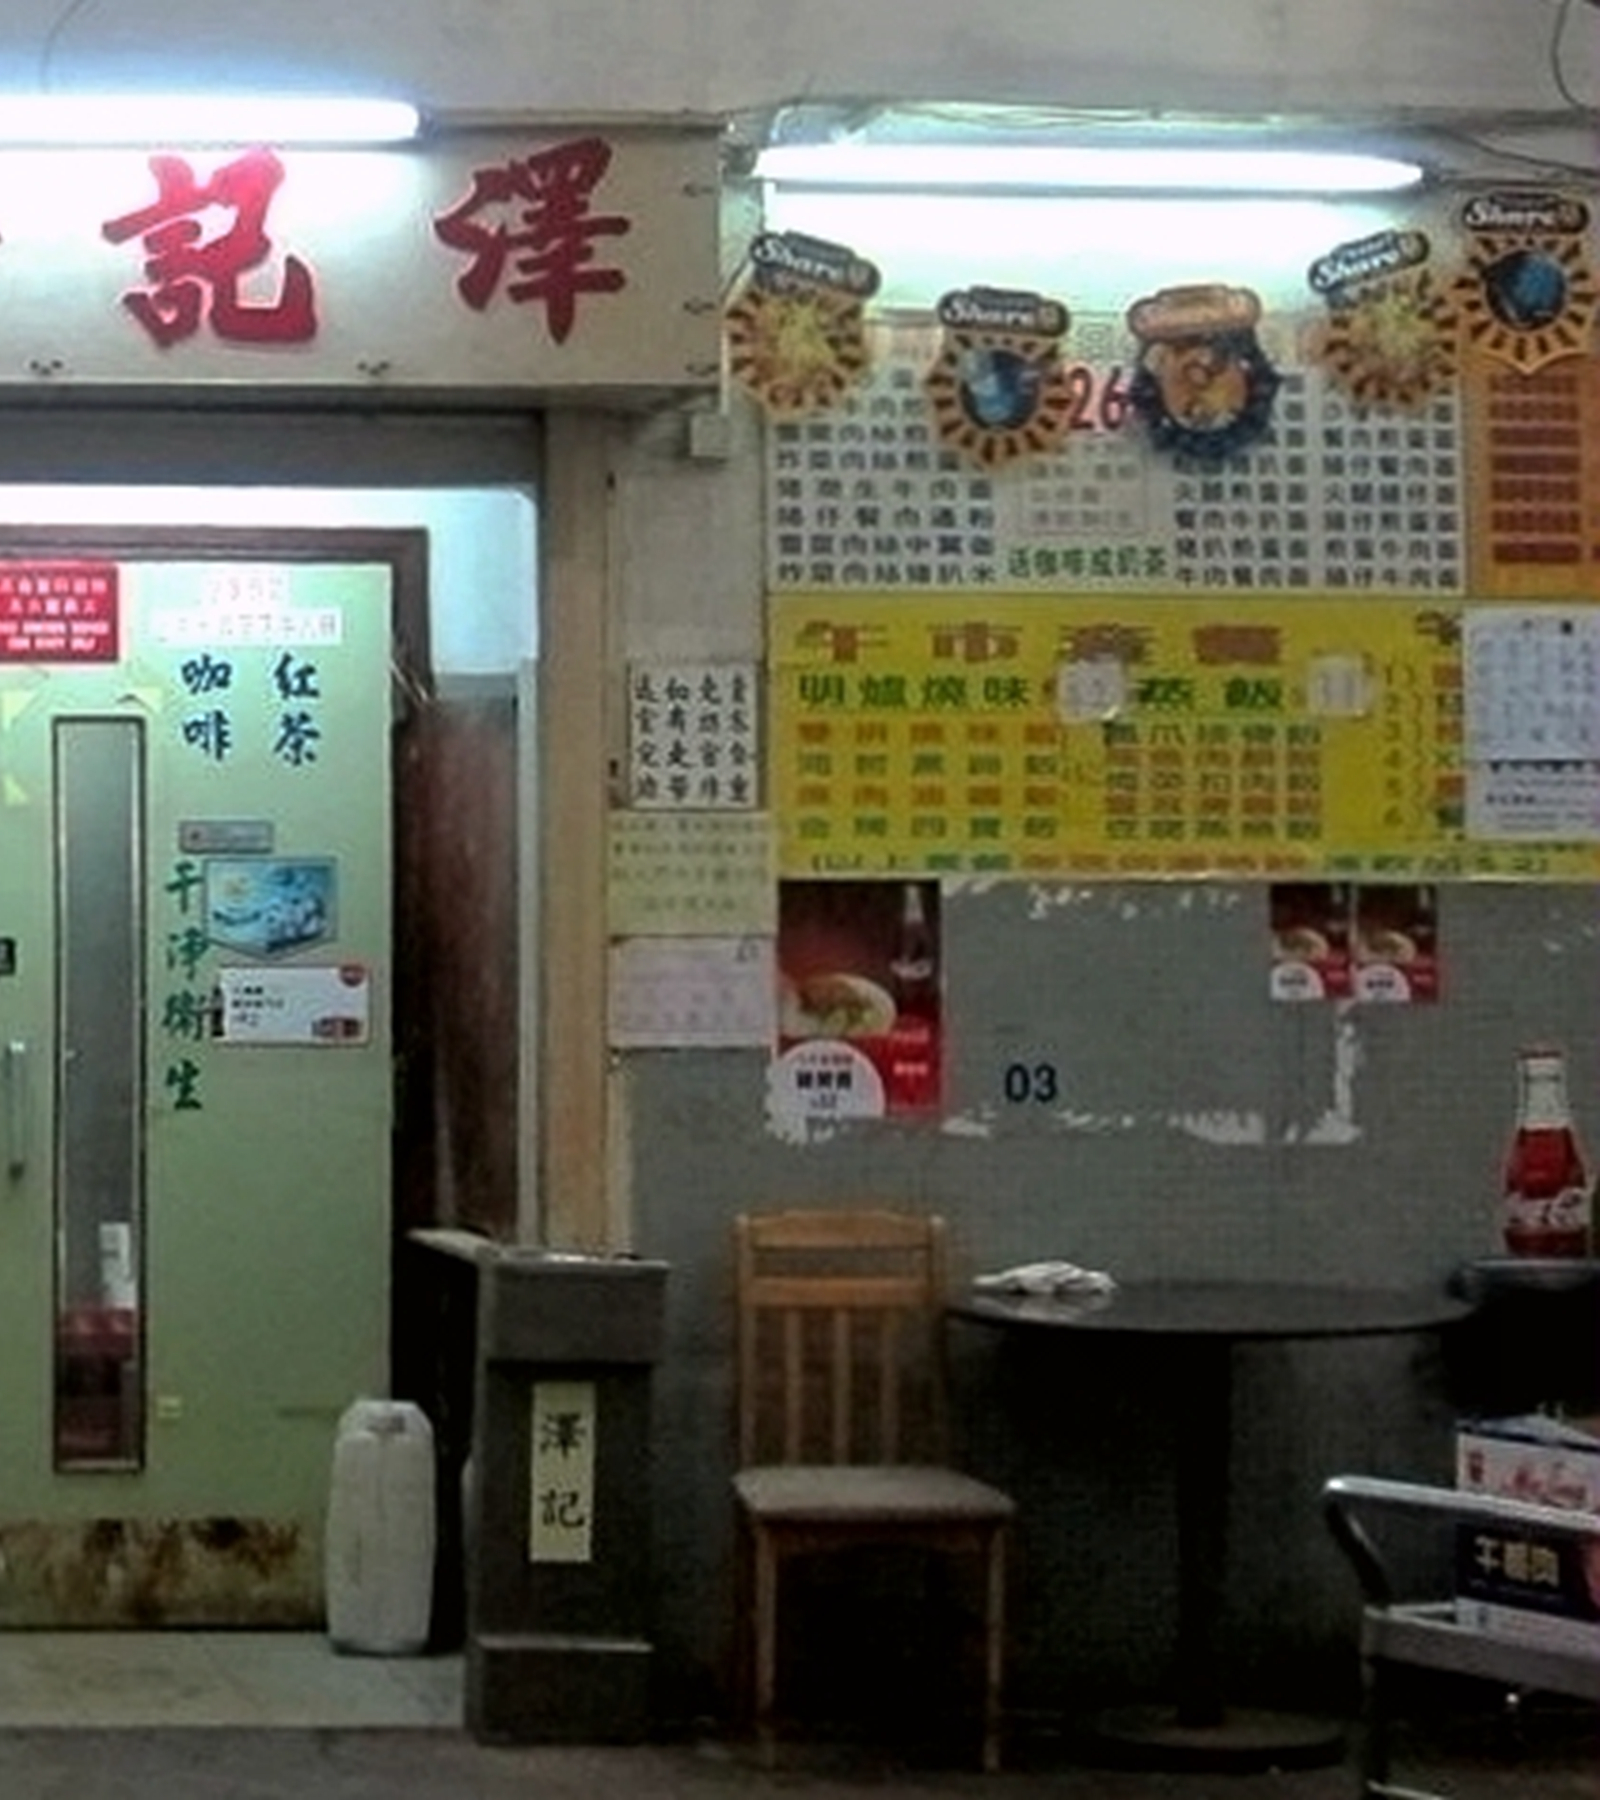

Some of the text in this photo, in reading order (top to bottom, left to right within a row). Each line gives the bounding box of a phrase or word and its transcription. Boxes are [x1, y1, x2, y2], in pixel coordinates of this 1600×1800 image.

[754, 239, 844, 280] Share
[1313, 250, 1400, 288] Share
[944, 299, 1035, 325] Share
[1068, 366, 1126, 430] 26
[180, 652, 232, 762] 咖啡
[274, 652, 321, 766] 紅茶
[1005, 1063, 1058, 1103] 03
[539, 1412, 586, 1529] 澤記
